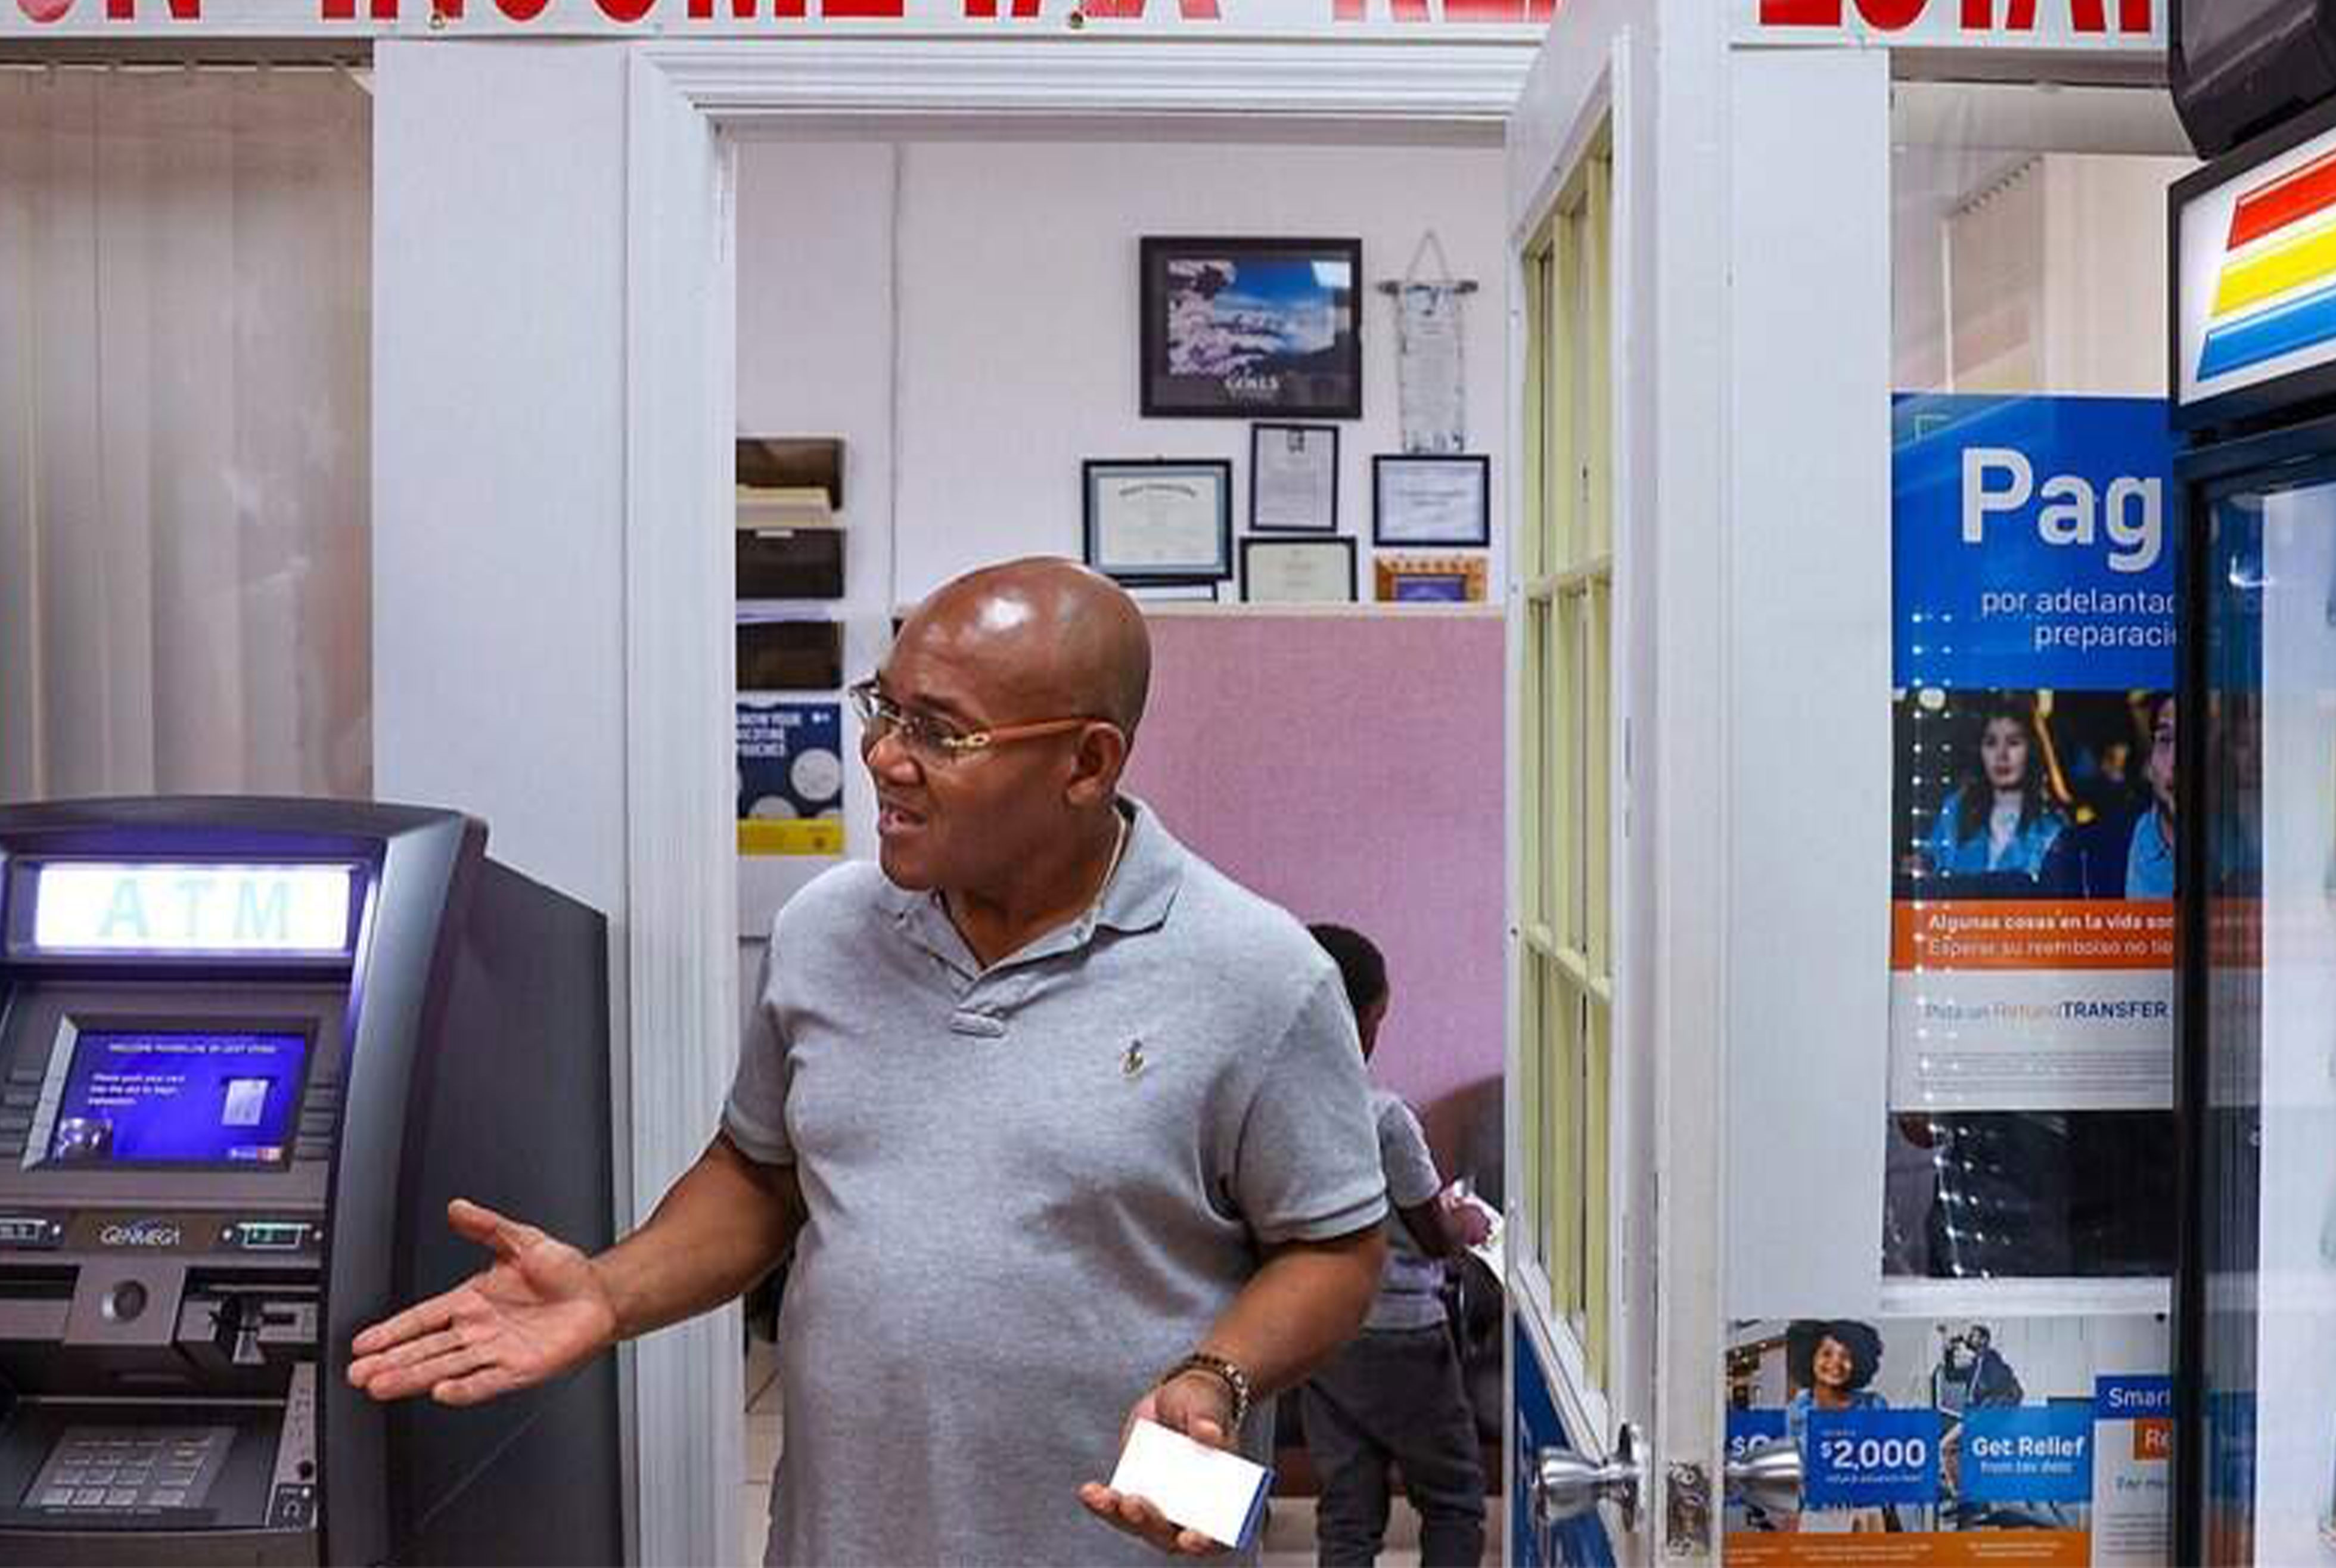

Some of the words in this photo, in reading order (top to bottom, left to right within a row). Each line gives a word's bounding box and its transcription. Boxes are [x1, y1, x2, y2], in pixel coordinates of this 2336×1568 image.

[1962, 448, 2163, 572] Pag
[1982, 592, 2026, 617] por
[2034, 621, 2175, 653] preparaci
[97, 878, 291, 939] ATM
[1930, 914, 1999, 934] Algunas
[2005, 917, 2055, 929] cosas
[2060, 917, 2081, 929] en
[2085, 914, 2102, 929] la
[2105, 914, 2142, 929] vida
[2124, 942, 2149, 954] no
[1820, 1438, 1925, 1471] $2,000
[1972, 1436, 2011, 1457] Get
[2018, 1436, 2085, 1457] Relief
